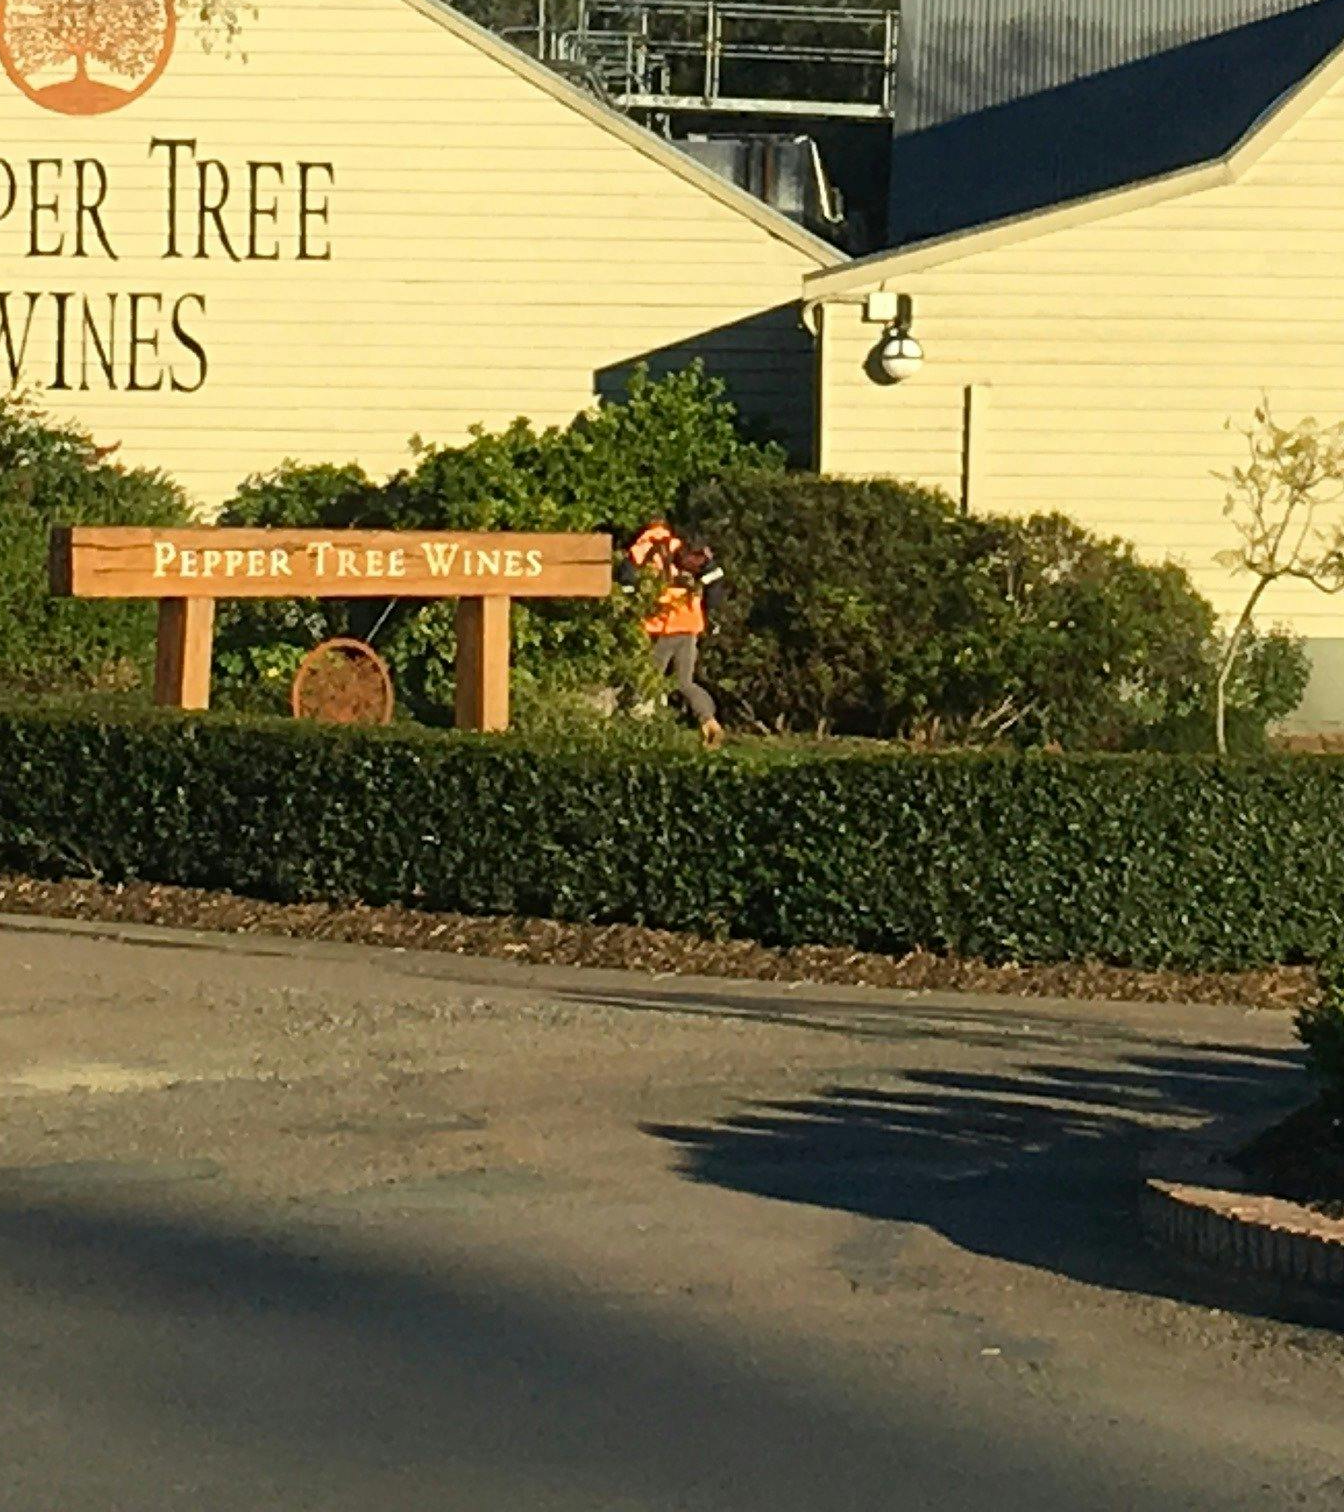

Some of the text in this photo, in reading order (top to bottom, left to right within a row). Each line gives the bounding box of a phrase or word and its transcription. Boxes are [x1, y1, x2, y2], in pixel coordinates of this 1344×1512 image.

[149, 136, 335, 262] TREE
[152, 540, 544, 578] PEPPER TREE WINES
